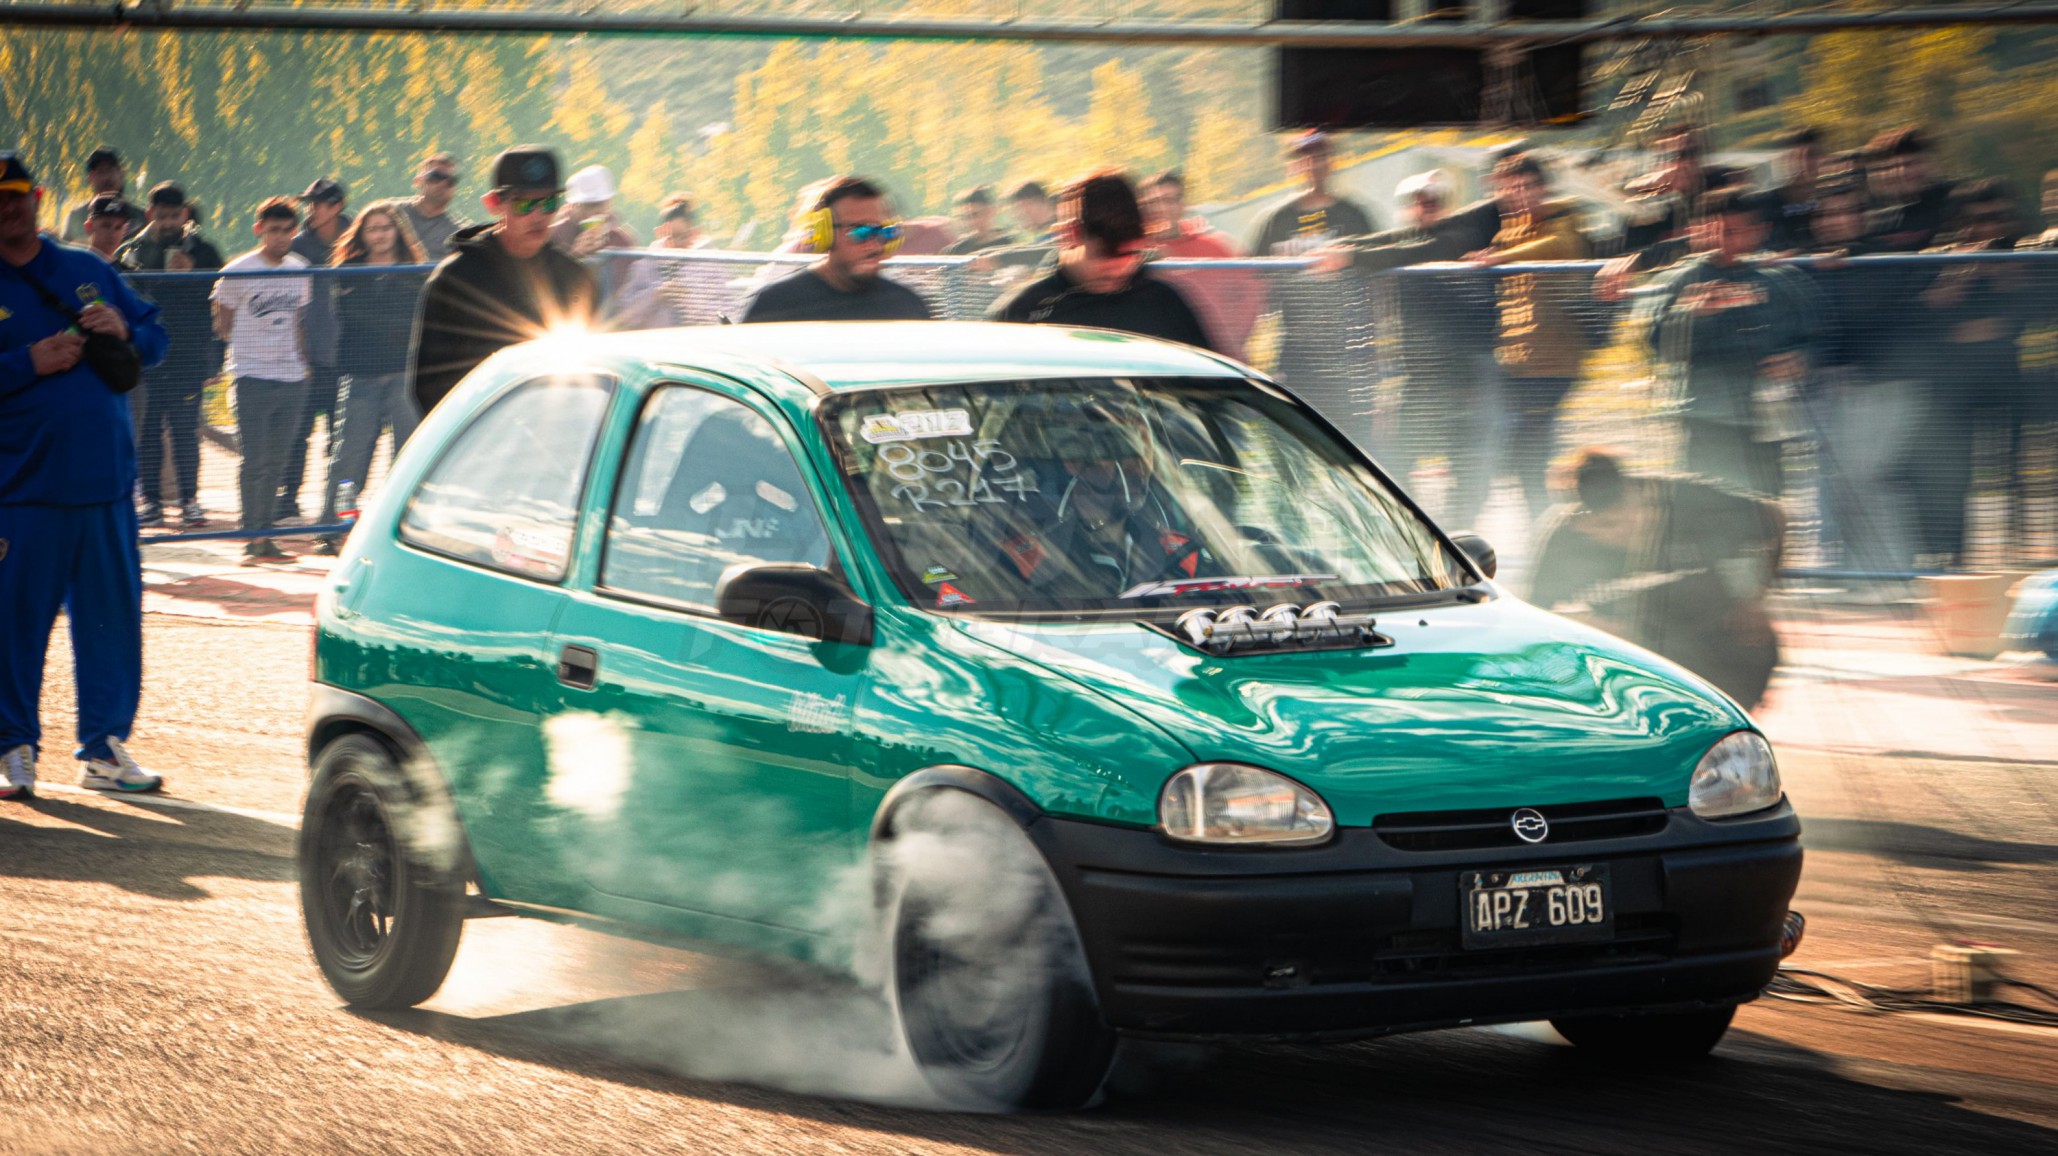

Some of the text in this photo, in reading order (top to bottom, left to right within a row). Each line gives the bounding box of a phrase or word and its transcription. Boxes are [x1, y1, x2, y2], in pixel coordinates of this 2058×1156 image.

[878, 438, 1018, 481] 8045
[890, 473, 1041, 513] R217
[1477, 884, 1604, 931] APZ 609
